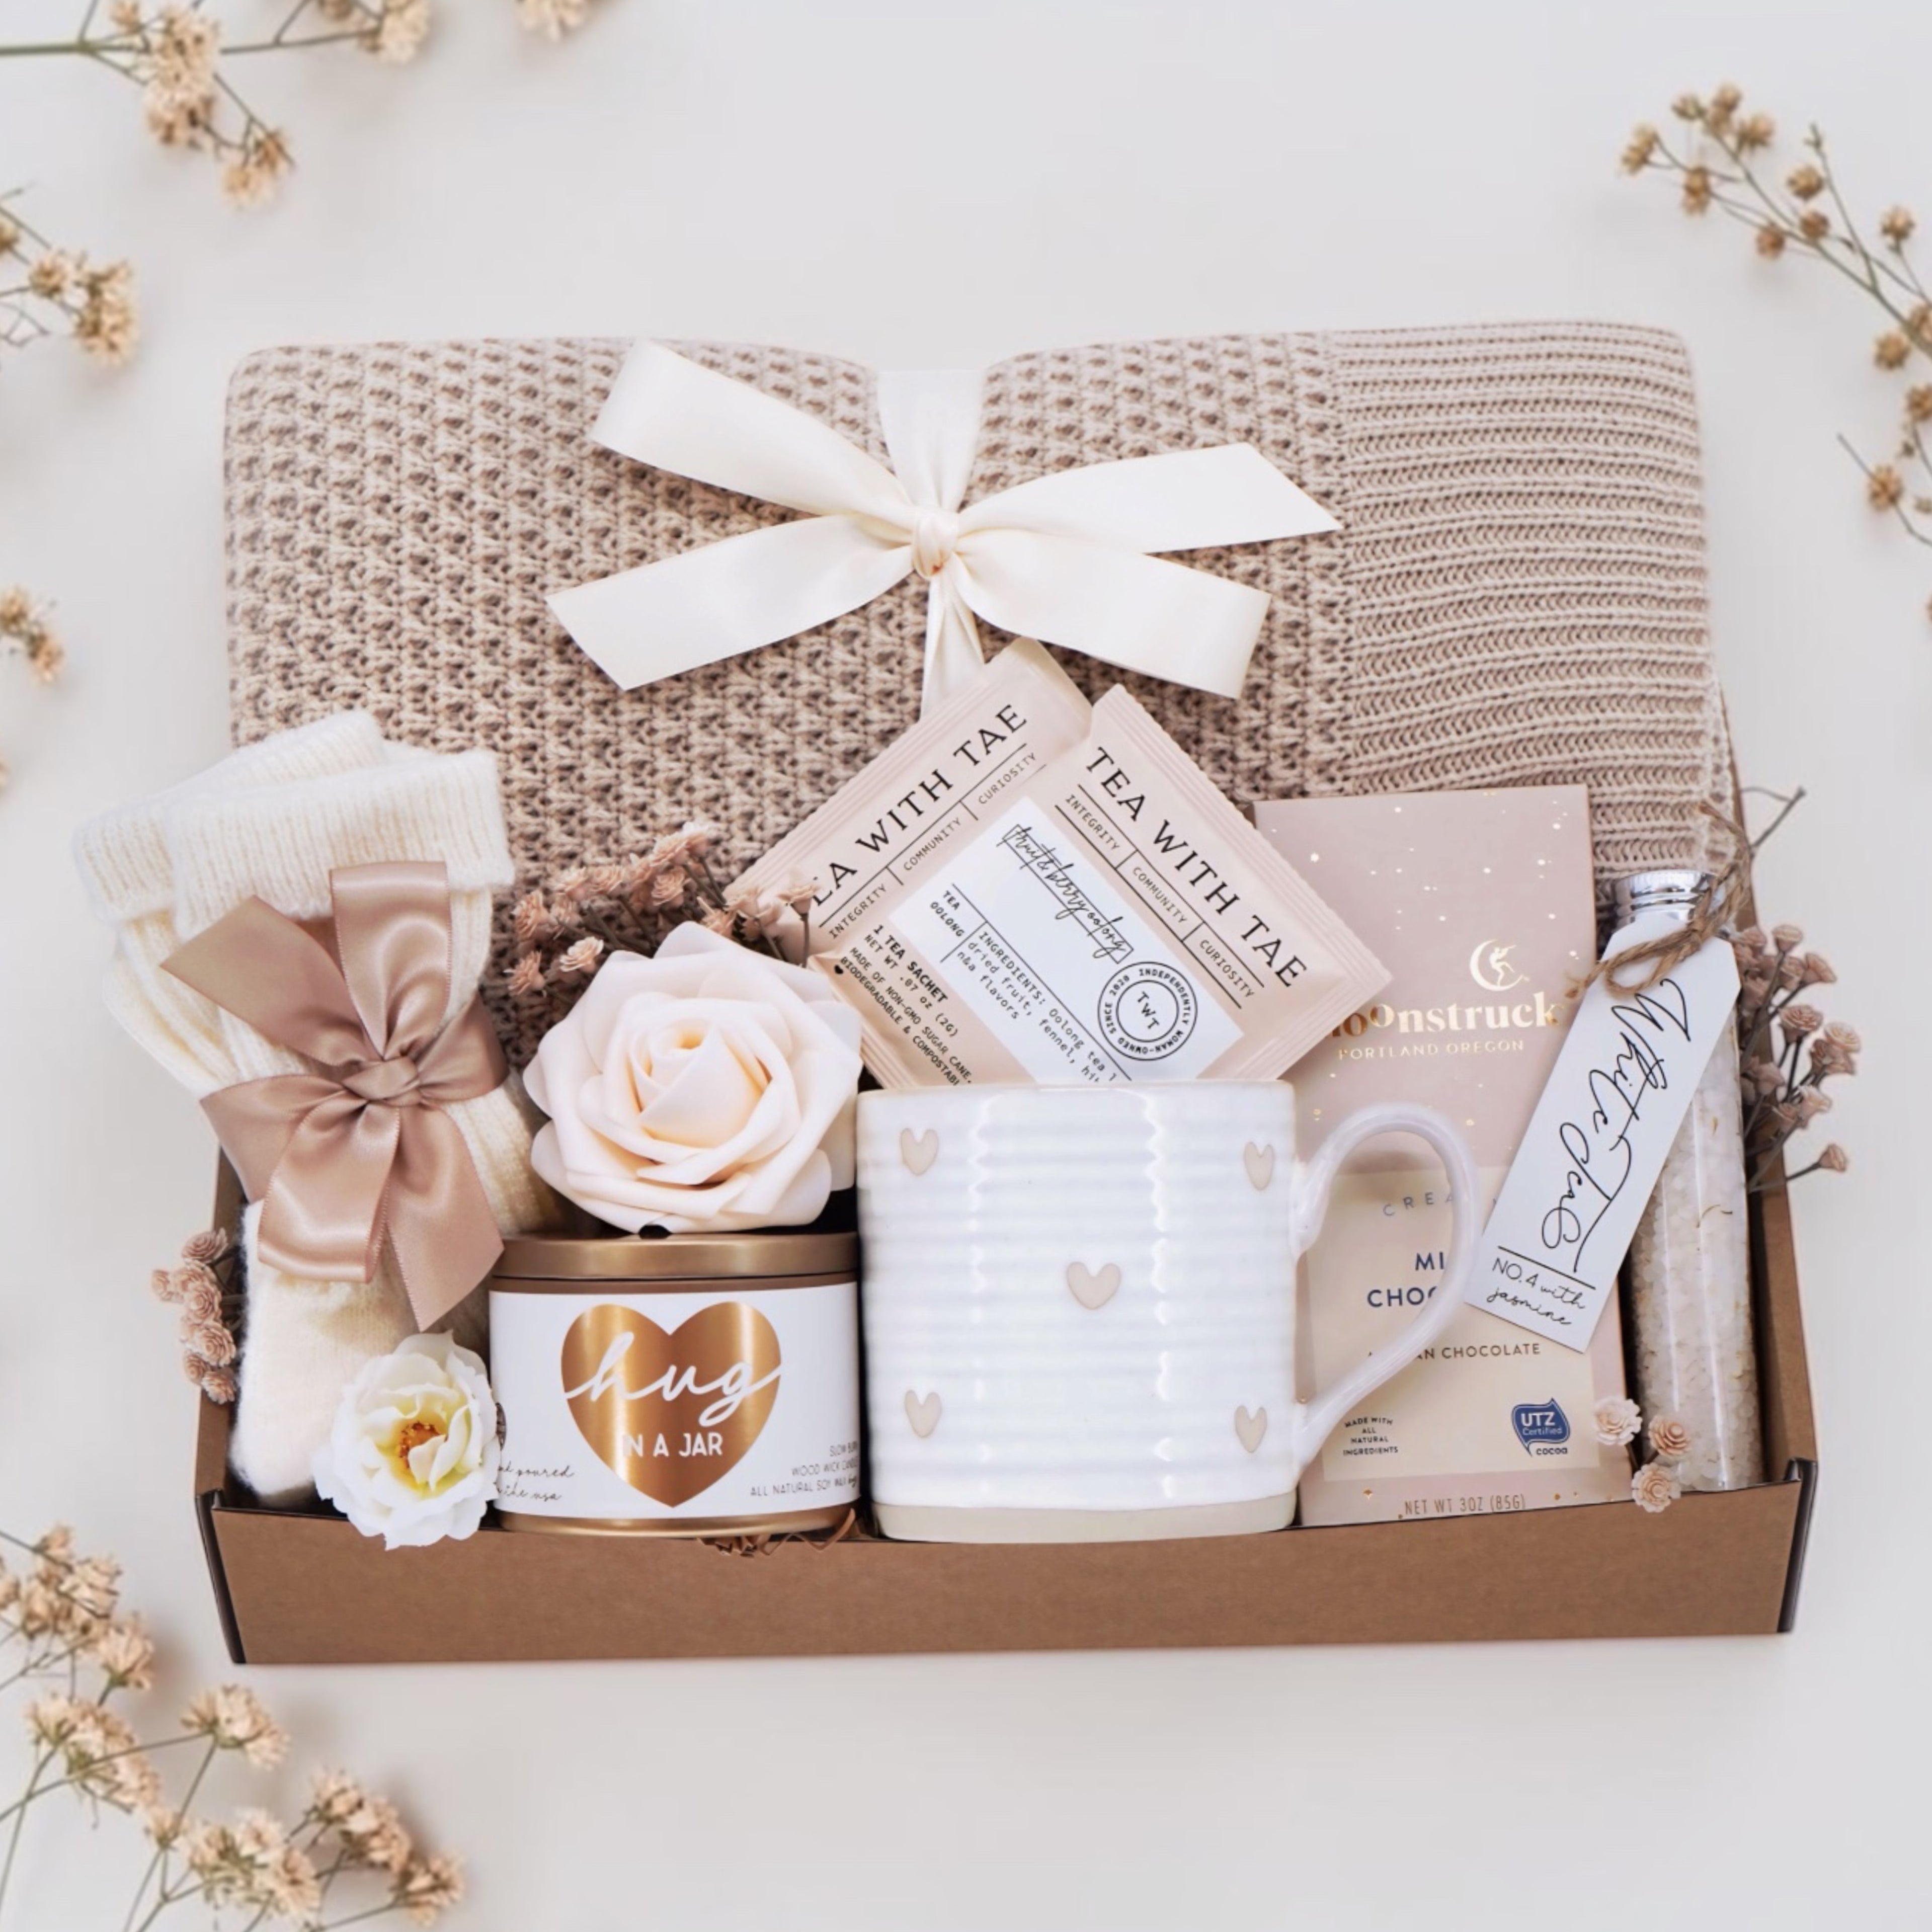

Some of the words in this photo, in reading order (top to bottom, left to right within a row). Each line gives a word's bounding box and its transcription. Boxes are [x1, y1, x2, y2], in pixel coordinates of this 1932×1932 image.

[855, 768, 953, 853] WITH
[952, 704, 1027, 766] TAE
[828, 884, 888, 939] INTEGRITY
[903, 817, 962, 871] COMMUNITY
[978, 752, 1037, 805] CURIOSITY
[1086, 747, 1146, 822] TEA
[1153, 819, 1240, 915] WITH
[1241, 915, 1307, 988] TAE
[942, 890, 960, 910] TEA
[1065, 794, 1120, 851] INTEGRITY
[1132, 866, 1188, 925] COMMUNITY
[1199, 939, 1255, 999] CURIOSITY
[930, 902, 965, 938] OOLONG
[873, 924, 884, 935] 1
[884, 935, 907, 959] TEA
[907, 960, 948, 1003] SACHET
[840, 956, 904, 1025] BIODEGRADABLE
[902, 1025, 911, 1034] &
[864, 933, 883, 953] NET
[883, 954, 899, 970] WT
[899, 976, 918, 992] .07
[920, 996, 933, 1009] oz
[935, 1013, 958, 1038] (2G)
[957, 950, 976, 972] n&a
[980, 975, 1019, 1020] flavors
[979, 931, 1046, 1005] INGREDIENTS:
[1049, 1008, 1085, 1050] Oolong
[1087, 1051, 1105, 1072] tea
[1139, 968, 1191, 1025] INDEPENDENTLY
[849, 947, 873, 972] MADE
[872, 971, 887, 985] OF
[885, 986, 921, 1025] NON-GMO
[921, 1026, 949, 1055] SUGAR
[949, 1056, 972, 1083] CANE.
[968, 941, 1000, 974] dried
[1001, 977, 1032, 1016] fruit,
[1038, 1018, 1075, 1064] fennel,
[1104, 1002, 1117, 1034] SINCE
[1137, 991, 1160, 1029] TWT
[1117, 1030, 1184, 1055] WOMAN-OWNED
[1339, 1043, 1438, 1061] PORTLAND
[1446, 1040, 1524, 1054] OREGON
[1588, 978, 1692, 1152] White
[1486, 1286, 1572, 1325] jasmine
[1541, 1285, 1586, 1309] with
[1441, 1342, 1541, 1359] CHOCOLATE
[564, 1331, 781, 1427] hug
[1344, 1417, 1368, 1428] MADE
[1371, 1417, 1393, 1425] WITH
[1520, 1411, 1556, 1426] UTZ
[1522, 1426, 1563, 1436] Certified
[653, 1432, 670, 1458] A
[678, 1431, 723, 1458] JAR
[1343, 1446, 1399, 1456] INGREDIENTS
[1350, 1435, 1389, 1443] NATURAL
[1536, 1447, 1568, 1456] cocoa
[515, 1465, 575, 1480] poured
[792, 1463, 821, 1476] WOOD
[750, 1486, 768, 1496] ALL
[772, 1482, 813, 1495] NATURAL
[1405, 1499, 1428, 1515] NET
[1434, 1498, 1453, 1513] WT
[1460, 1496, 1484, 1511] 3OZ
[1490, 1493, 1526, 1512] (85G)
